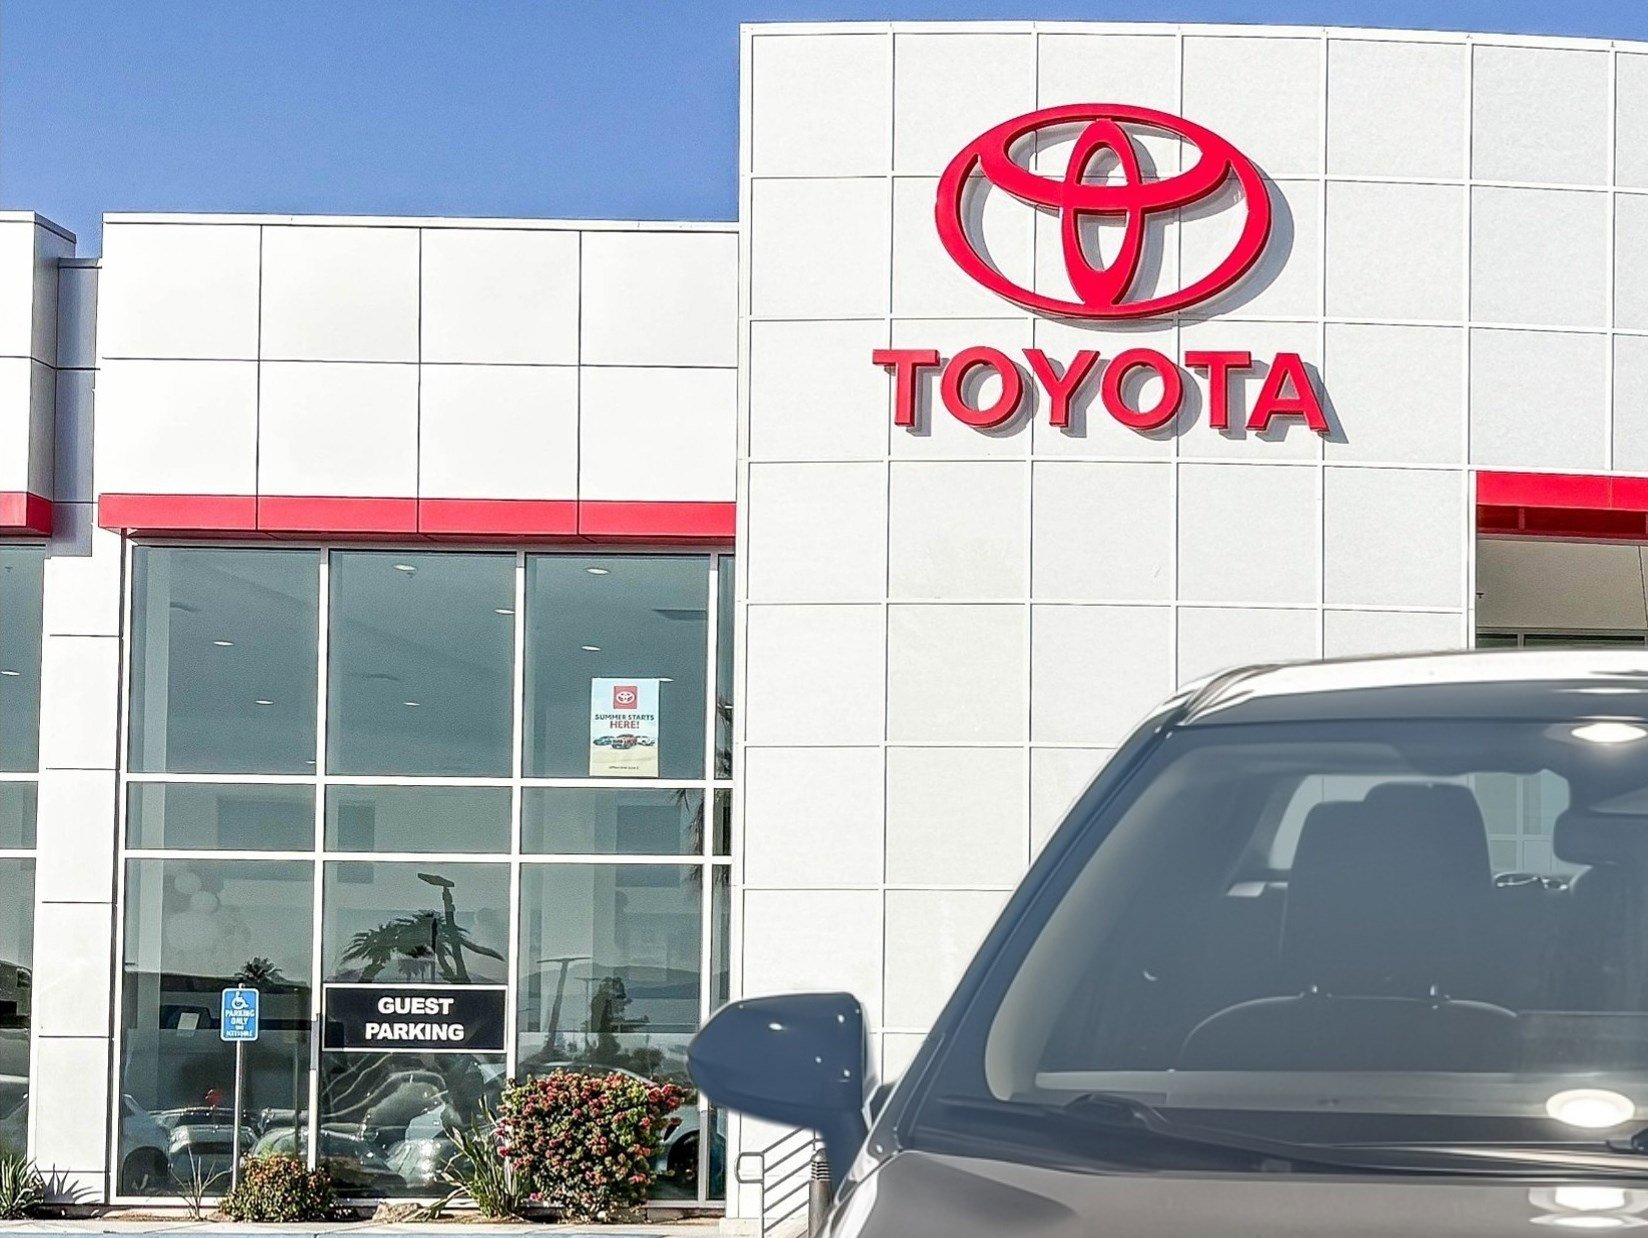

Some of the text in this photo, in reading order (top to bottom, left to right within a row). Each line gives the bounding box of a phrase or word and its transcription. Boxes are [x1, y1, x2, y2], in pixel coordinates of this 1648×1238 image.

[873, 345, 1330, 432] TOYOTA
[609, 720, 640, 729] HERE!
[377, 997, 455, 1015] GUEST
[365, 1023, 465, 1041] PARKING
